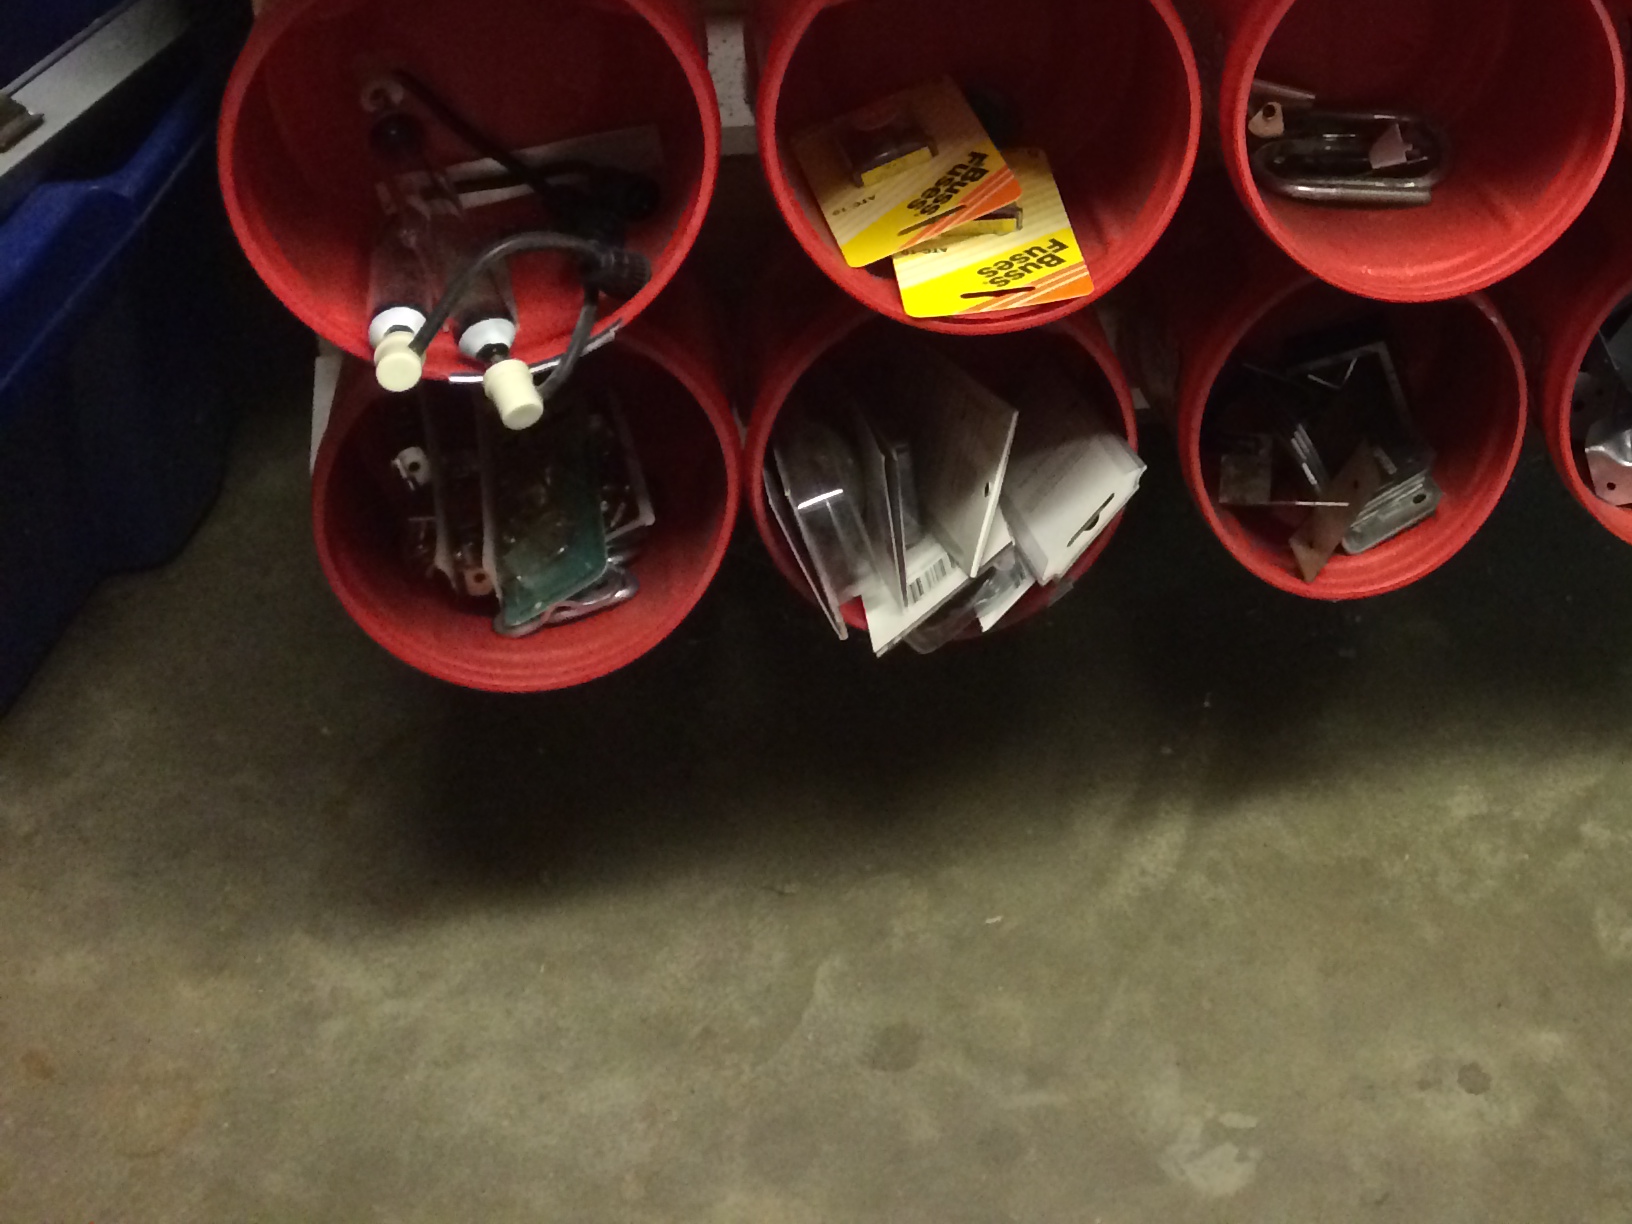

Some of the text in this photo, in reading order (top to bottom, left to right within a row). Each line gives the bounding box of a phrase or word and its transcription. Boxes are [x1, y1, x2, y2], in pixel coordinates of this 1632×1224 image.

[907, 151, 988, 211] Fuses
[920, 167, 989, 215] Buss
[977, 238, 1069, 277] Fuses
[989, 255, 1067, 287] Buss
